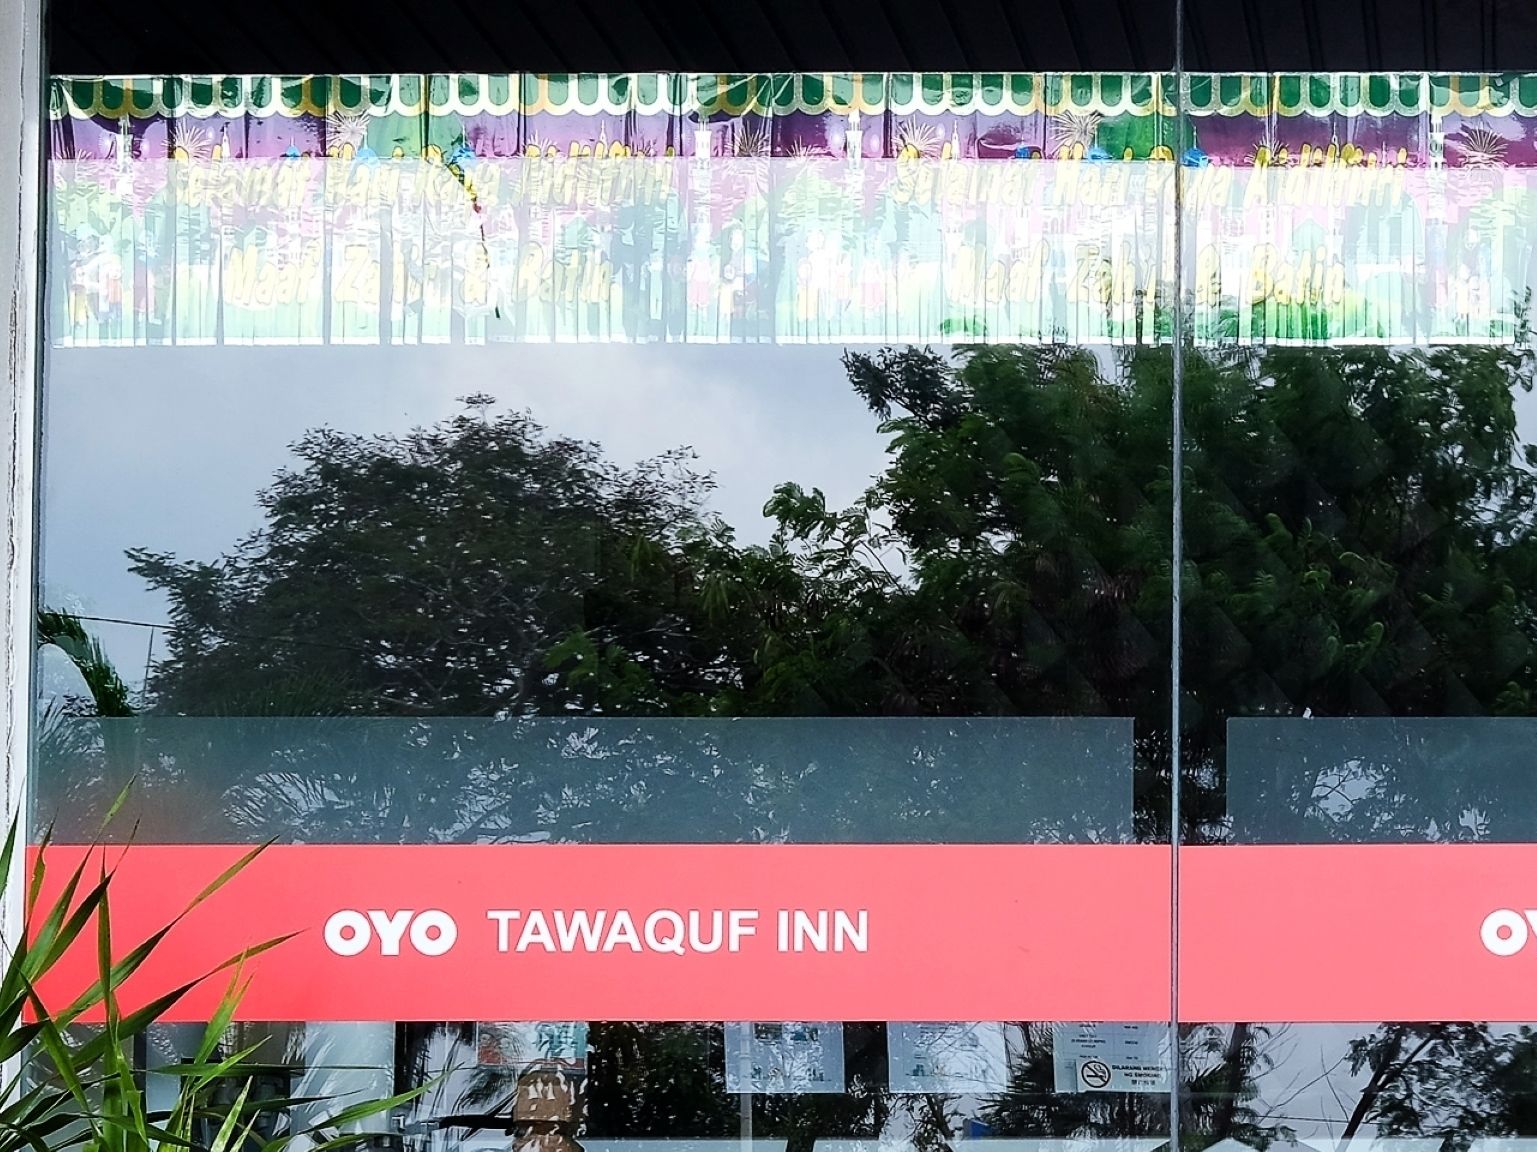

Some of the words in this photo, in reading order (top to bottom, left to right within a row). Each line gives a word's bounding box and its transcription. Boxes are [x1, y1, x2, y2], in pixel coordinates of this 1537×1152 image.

[323, 908, 459, 957] OYO
[486, 909, 759, 956] TAWAQUF
[776, 909, 869, 953] INN
